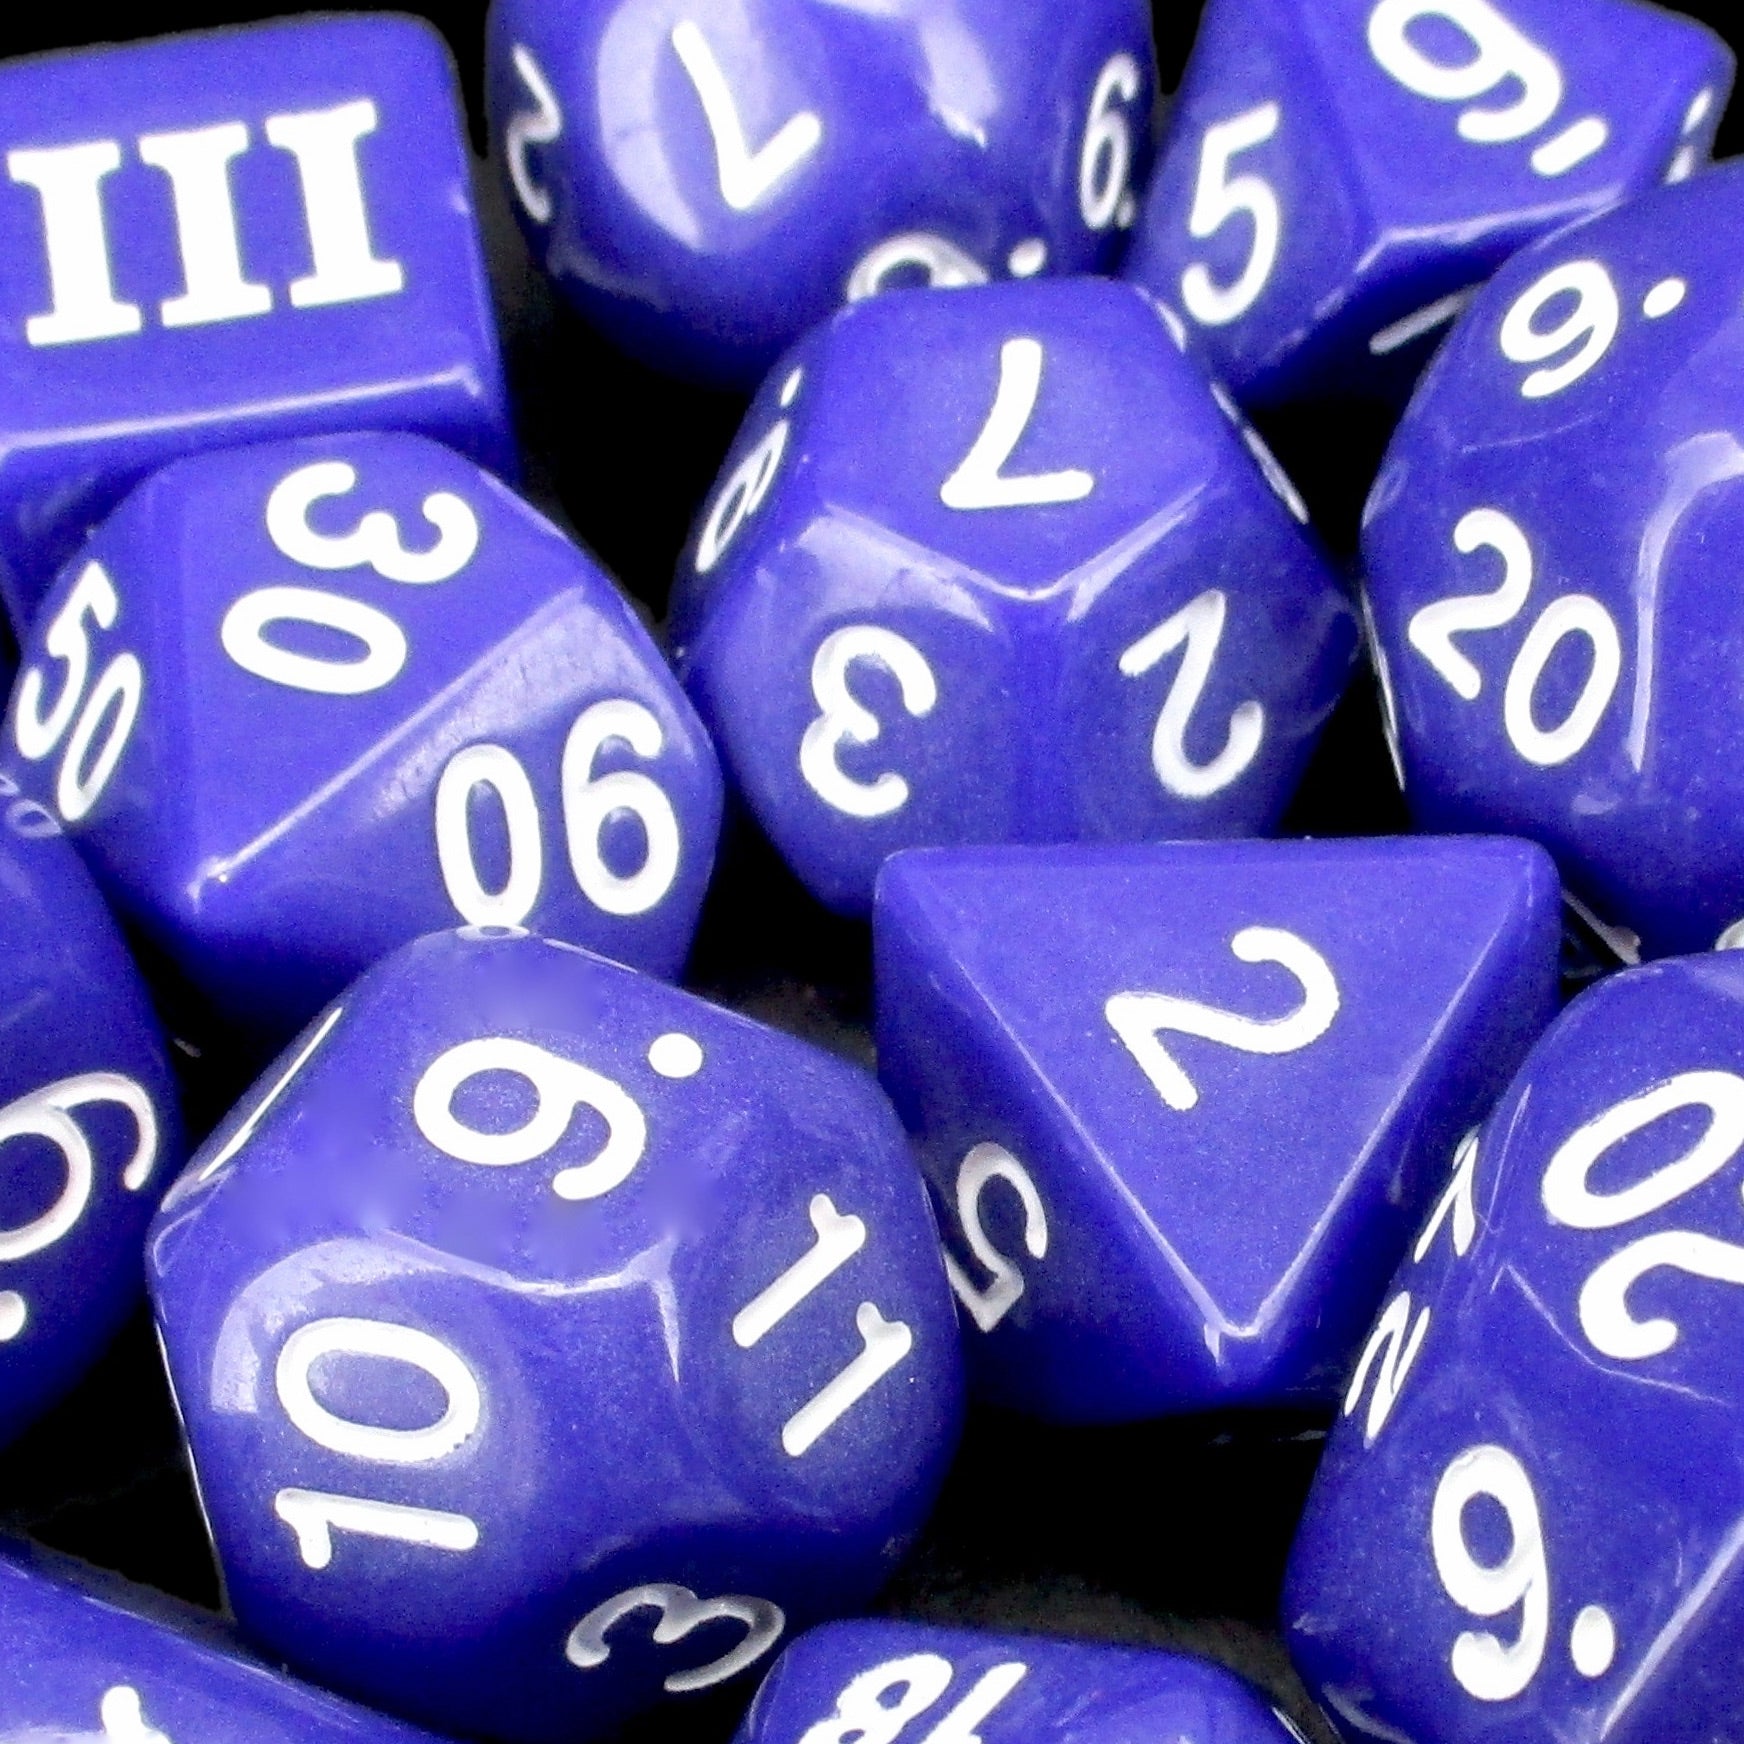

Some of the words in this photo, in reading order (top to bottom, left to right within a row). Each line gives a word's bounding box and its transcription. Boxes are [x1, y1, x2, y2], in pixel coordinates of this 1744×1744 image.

[672, 20, 823, 209] 7
[1181, 102, 1282, 324] 5
[6, 98, 405, 347] III
[939, 337, 1095, 510] 7
[221, 460, 479, 695] 30
[1408, 508, 1622, 766] 20
[14, 560, 142, 822] 50
[798, 624, 939, 819] 3
[1119, 591, 1264, 799] 2
[1104, 925, 1341, 1112] 2
[732, 1193, 913, 1458] 11
[942, 1142, 1048, 1334] 5
[274, 1316, 481, 1570] 10
[566, 1582, 786, 1692] 3
